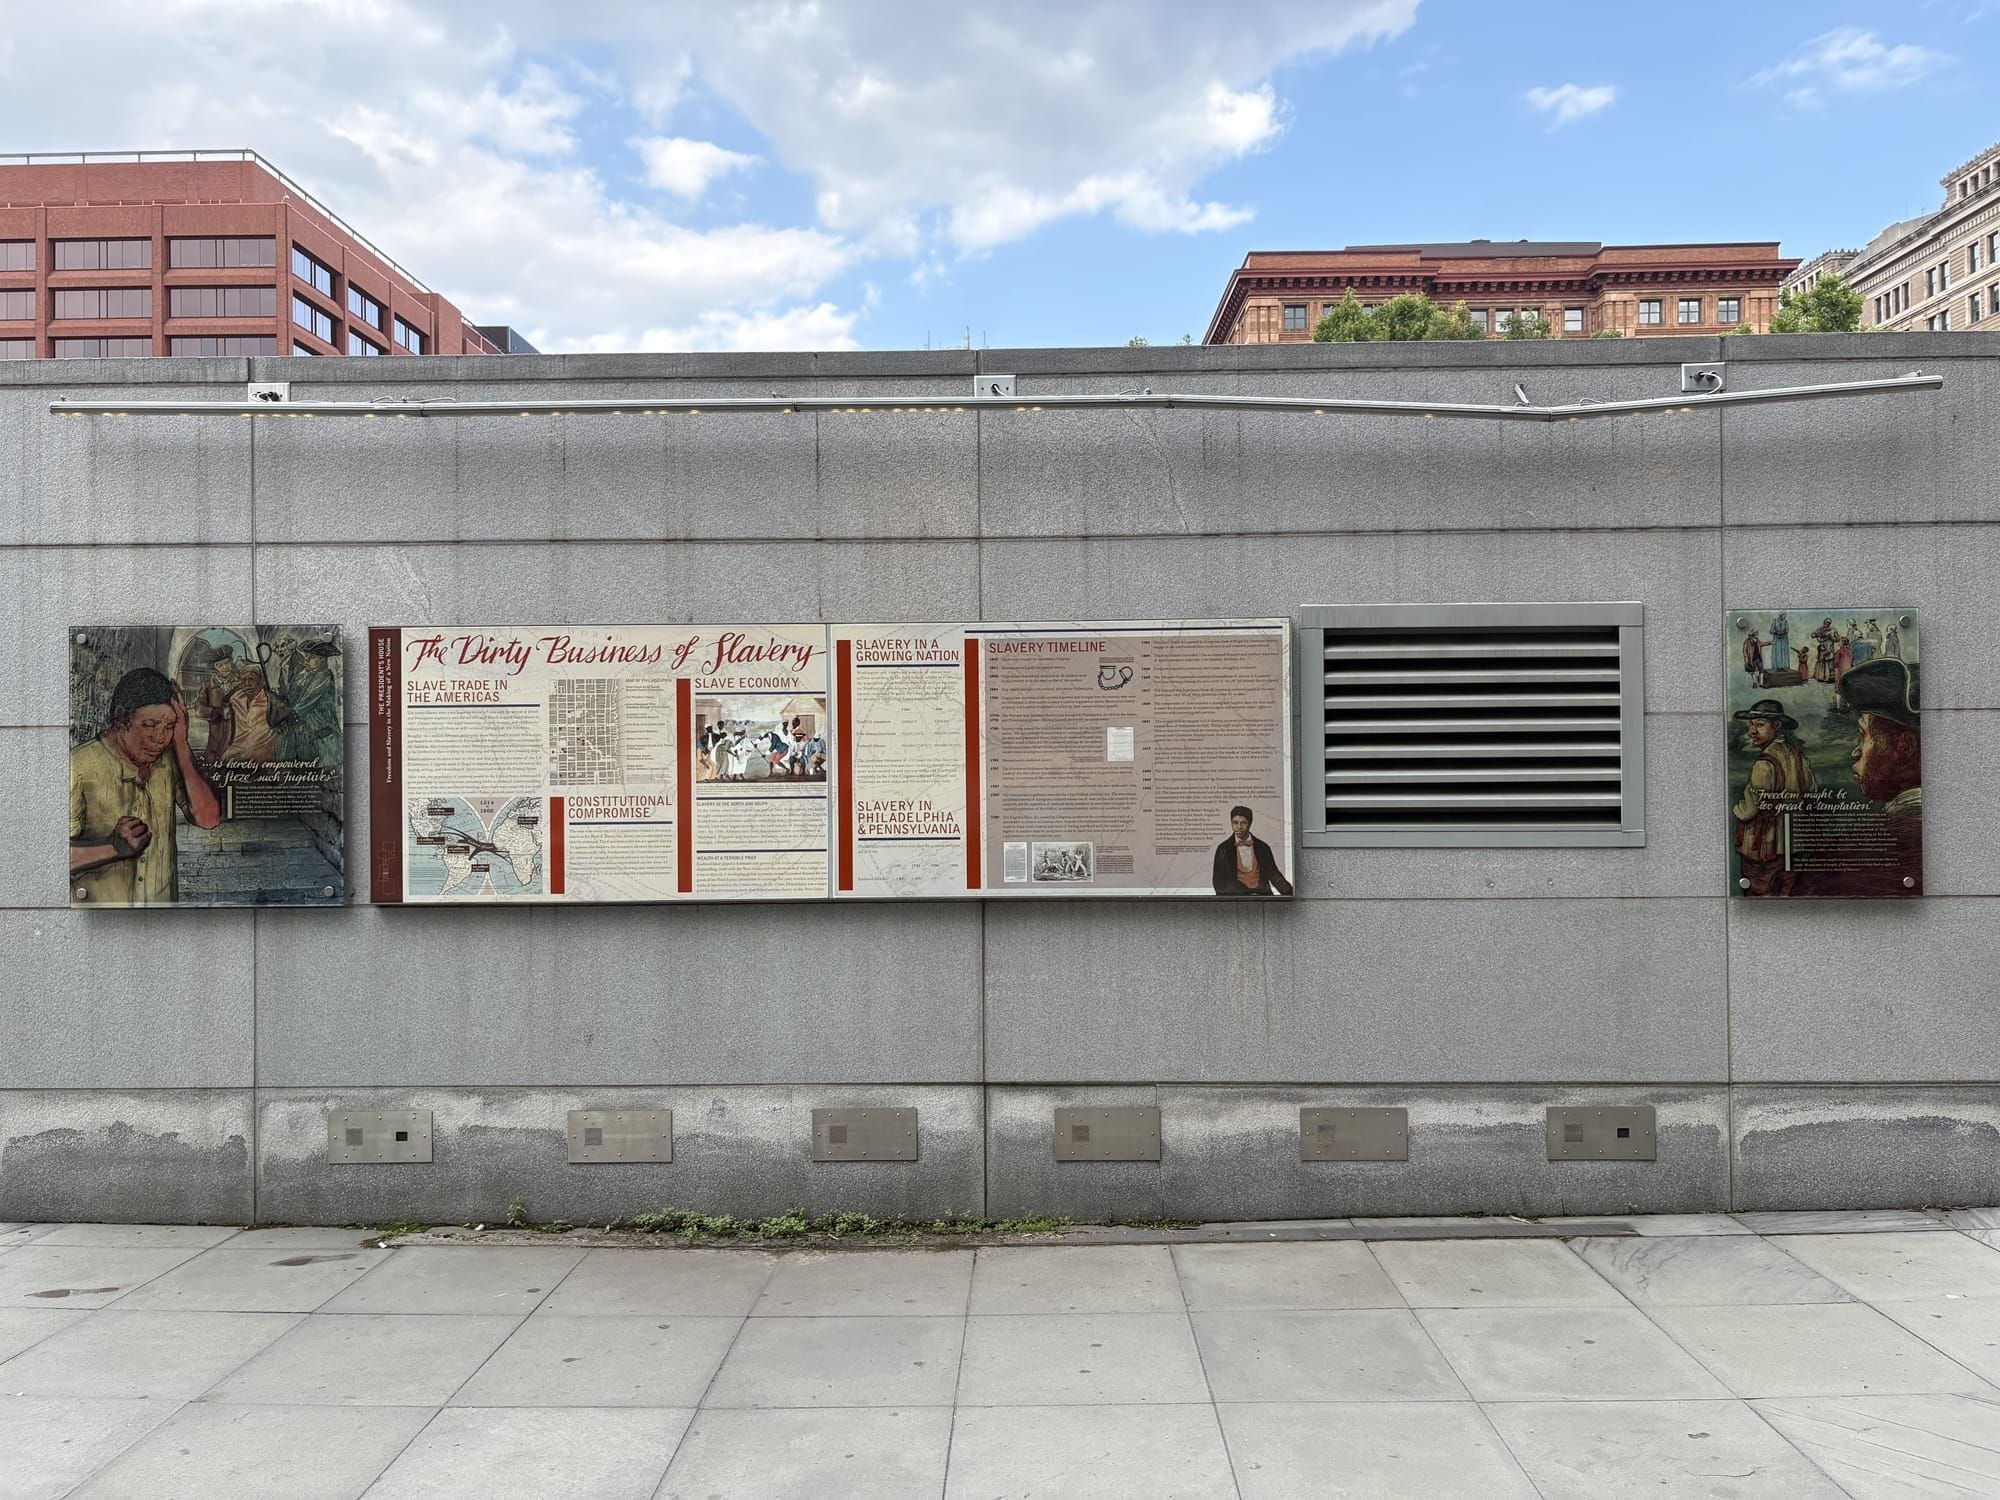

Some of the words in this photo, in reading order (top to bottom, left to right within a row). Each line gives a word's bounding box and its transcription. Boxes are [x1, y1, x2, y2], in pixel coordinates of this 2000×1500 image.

[856, 639, 911, 650] SLAVERY
[914, 639, 927, 649] IN
[931, 639, 939, 649] A
[989, 642, 1044, 653] SLAVERY
[1047, 641, 1106, 652] TIMELINE
[405, 634, 448, 673] The
[451, 634, 532, 676] Dirty
[536, 635, 661, 664] Business
[669, 635, 700, 670] of
[702, 632, 826, 675] Slavery
[856, 650, 912, 661] GROWING
[916, 650, 959, 661] NATION
[407, 680, 447, 691] SLAVE
[451, 680, 489, 690] TRADE
[495, 680, 508, 690] IN
[695, 677, 735, 688] SLAVE
[739, 677, 800, 688] ECONOMY
[407, 692, 431, 703] THE
[435, 691, 500, 702] AMERICAS
[226, 757, 259, 773] hereby
[261, 757, 319, 773] empowered
[210, 771, 221, 781] to
[568, 795, 673, 807] CONSTITUTIONAL
[1803, 788, 1833, 803] might
[858, 800, 914, 811] SLAVERY
[919, 800, 932, 811] IN
[1774, 801, 1804, 816] great
[568, 807, 651, 818] COMPROMISE
[858, 812, 954, 823] PHILADELPHIA
[858, 824, 866, 835] &
[869, 823, 960, 834] PENNSYLVANIA
